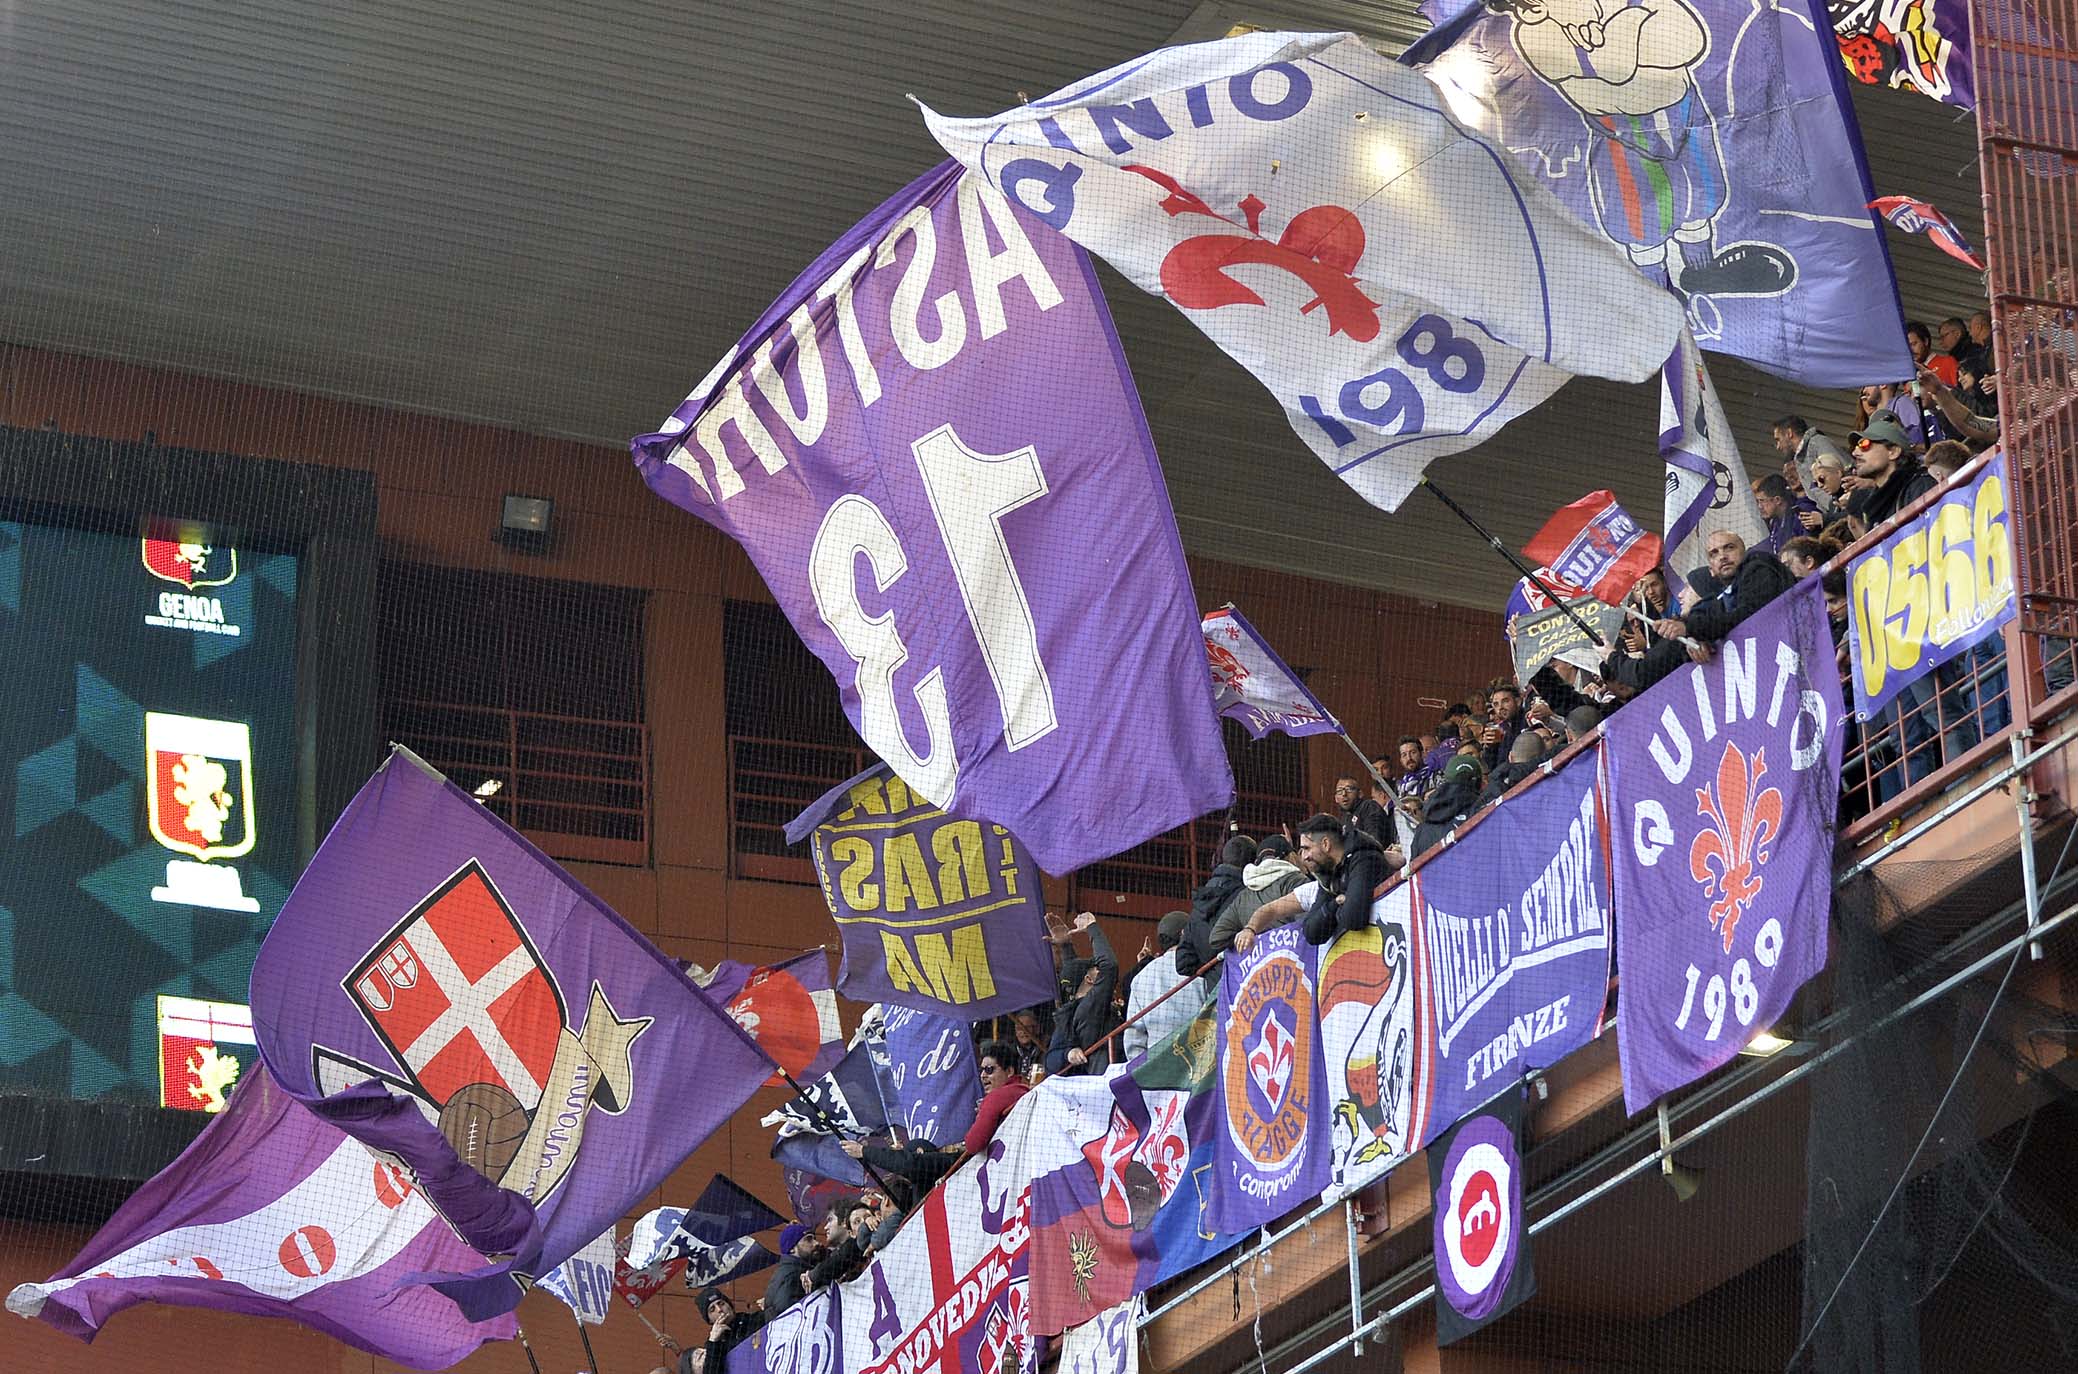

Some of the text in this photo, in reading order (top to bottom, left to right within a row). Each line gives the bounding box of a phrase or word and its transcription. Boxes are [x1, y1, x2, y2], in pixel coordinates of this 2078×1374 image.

[159, 592, 225, 624] GENOA
[1539, 617, 1600, 646] CALCO
[1853, 475, 2011, 697] 0566
[1634, 638, 1827, 866] QUINTO
